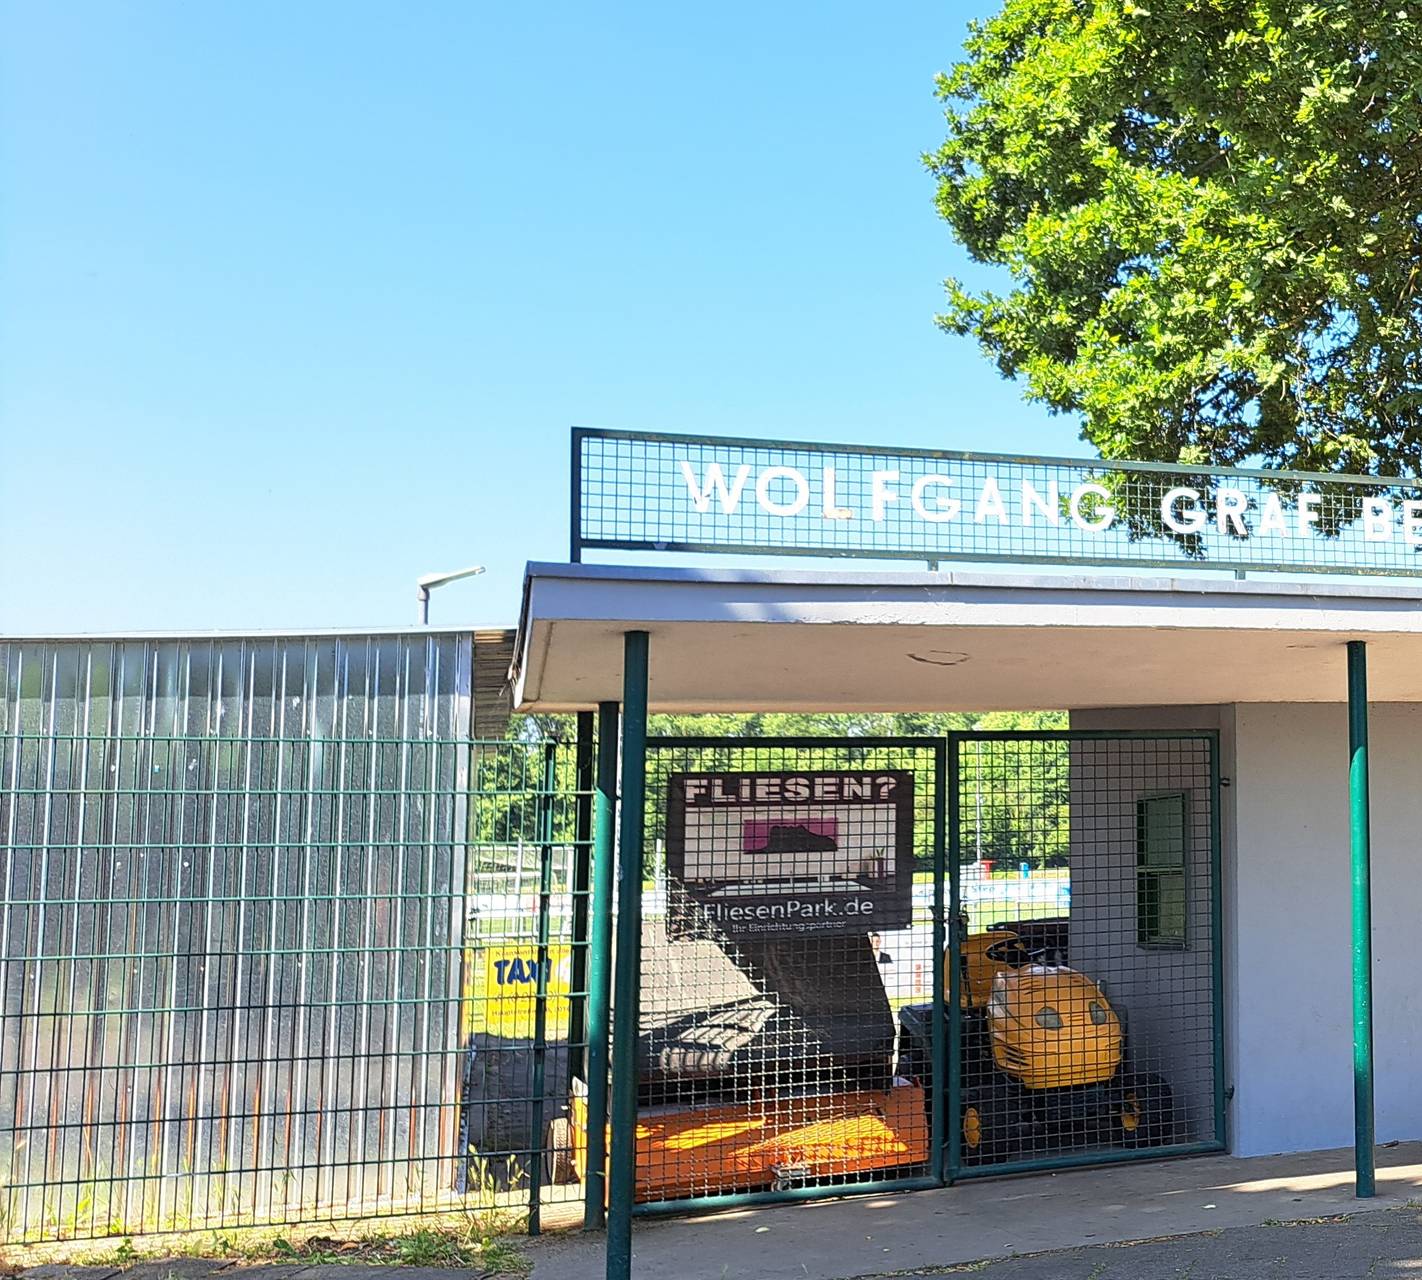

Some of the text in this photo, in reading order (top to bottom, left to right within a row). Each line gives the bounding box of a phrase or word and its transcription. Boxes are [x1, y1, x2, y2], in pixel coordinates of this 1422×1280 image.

[680, 460, 1116, 532] WOLFGANG
[1161, 487, 1321, 537] GRAF
[684, 776, 897, 803] FLIESEN?
[704, 897, 874, 922] FliesenPark.de
